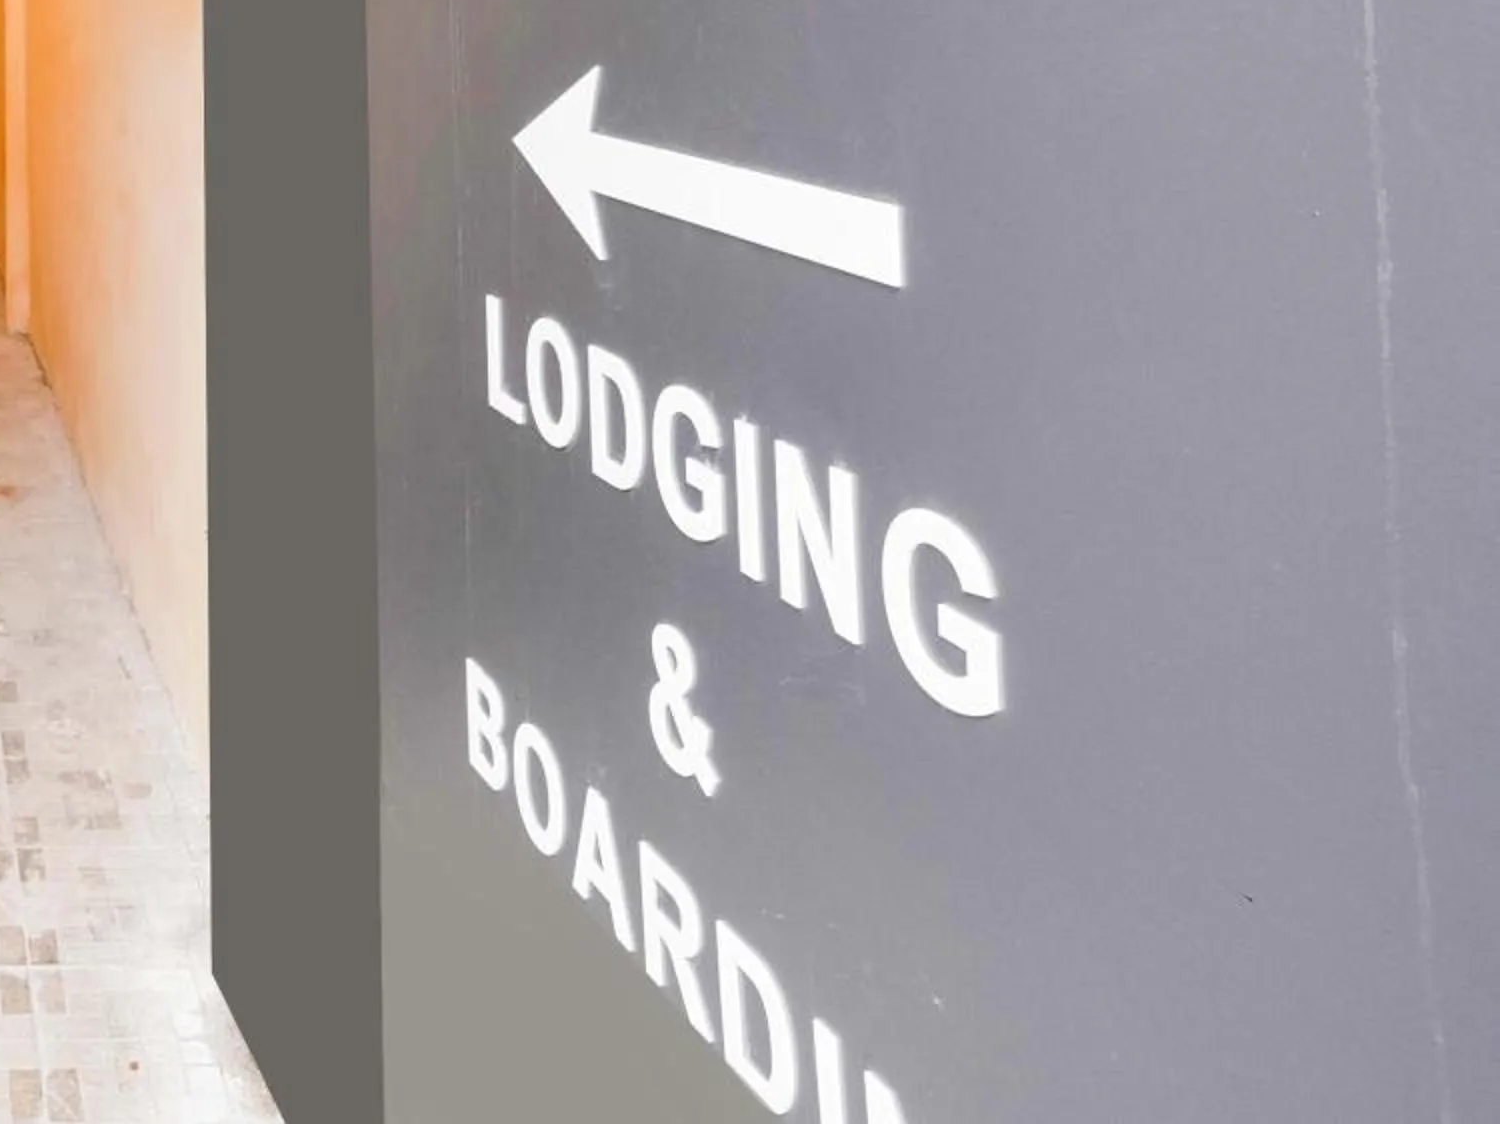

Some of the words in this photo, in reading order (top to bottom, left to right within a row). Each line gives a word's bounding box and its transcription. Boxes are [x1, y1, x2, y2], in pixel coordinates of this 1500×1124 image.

[485, 294, 1005, 718] LODGING
[648, 621, 721, 798] &
[466, 657, 906, 1124] BOARDI
